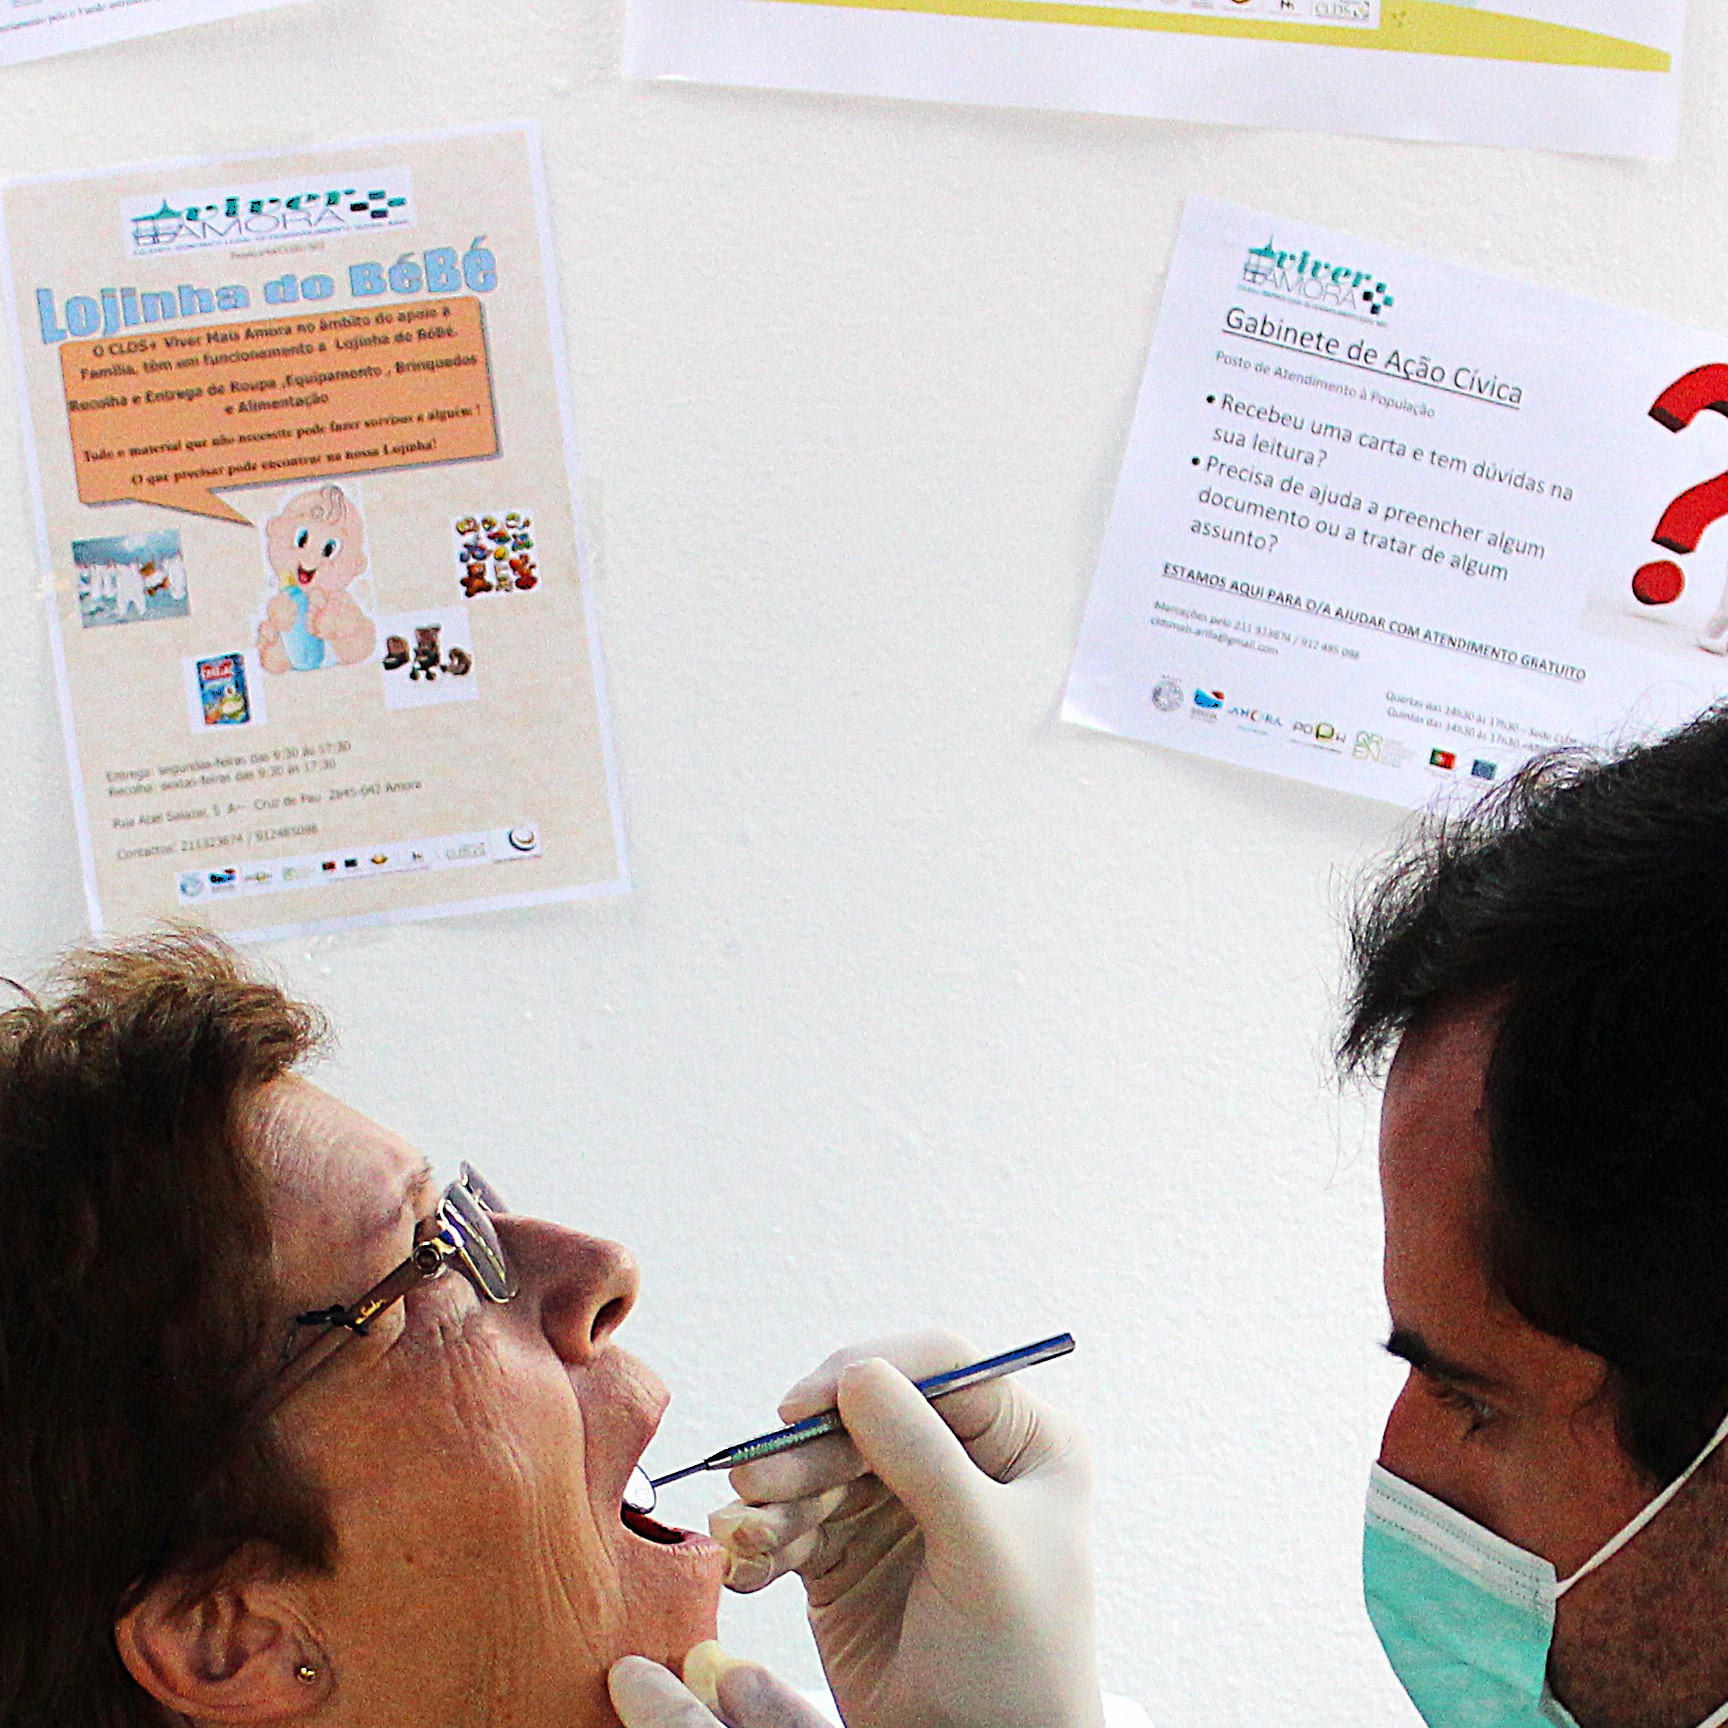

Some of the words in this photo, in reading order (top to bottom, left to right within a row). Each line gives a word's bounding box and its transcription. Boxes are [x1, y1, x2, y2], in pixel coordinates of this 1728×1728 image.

[173, 205, 345, 241] AMORA
[37, 279, 249, 343] Lojinha
[265, 274, 334, 304] do
[349, 237, 498, 300] BéBé
[1256, 264, 1360, 311] AMORA
[164, 333, 201, 348] Viver
[244, 323, 291, 339] Amora
[334, 332, 389, 351] Lojinha
[1224, 305, 1342, 356] Gabinete
[1345, 337, 1378, 365] de
[1382, 346, 1448, 388] Ação
[1452, 364, 1525, 403] Cívica
[143, 384, 203, 404] Entrega
[229, 376, 277, 394] Roupa
[394, 352, 477, 376] Brinquedos
[237, 392, 329, 414] Alimentação
[1215, 350, 1252, 370] Posto
[1254, 360, 1272, 375] de
[1273, 365, 1358, 397] Atendimento
[1359, 387, 1369, 400] à
[1370, 390, 1436, 420] População
[1212, 427, 1246, 448] sua
[1251, 432, 1328, 468] leitura?
[1220, 393, 1306, 431] Recebeu
[1309, 421, 1353, 443] uma
[1357, 428, 1408, 457] carta
[1412, 448, 1425, 462] e
[1428, 446, 1469, 473] tem
[1472, 458, 1547, 494] dúvidas
[1549, 483, 1574, 501] na
[1189, 514, 1279, 553] assunto?
[1204, 455, 1275, 488] Precisa
[1278, 474, 1306, 496] de
[1307, 481, 1364, 516] ajuda
[1367, 501, 1379, 516] a
[1382, 500, 1483, 546] preencher
[1485, 527, 1547, 562] algum
[1196, 485, 1311, 530] documento
[1314, 519, 1340, 537] ou
[1344, 527, 1357, 542] a
[1360, 528, 1416, 557] tratar
[1420, 543, 1446, 565] de
[1448, 551, 1510, 585] algum
[1162, 562, 1227, 589] ESTAMOS
[1229, 579, 1265, 601] AQUI
[1266, 588, 1303, 609] PARA
[1305, 598, 1333, 617] O/A
[1334, 605, 1386, 630] AJUDAR
[1388, 619, 1421, 639] COM
[1422, 628, 1519, 663] ATENDIMENTO
[1519, 652, 1587, 681] GRATUITO
